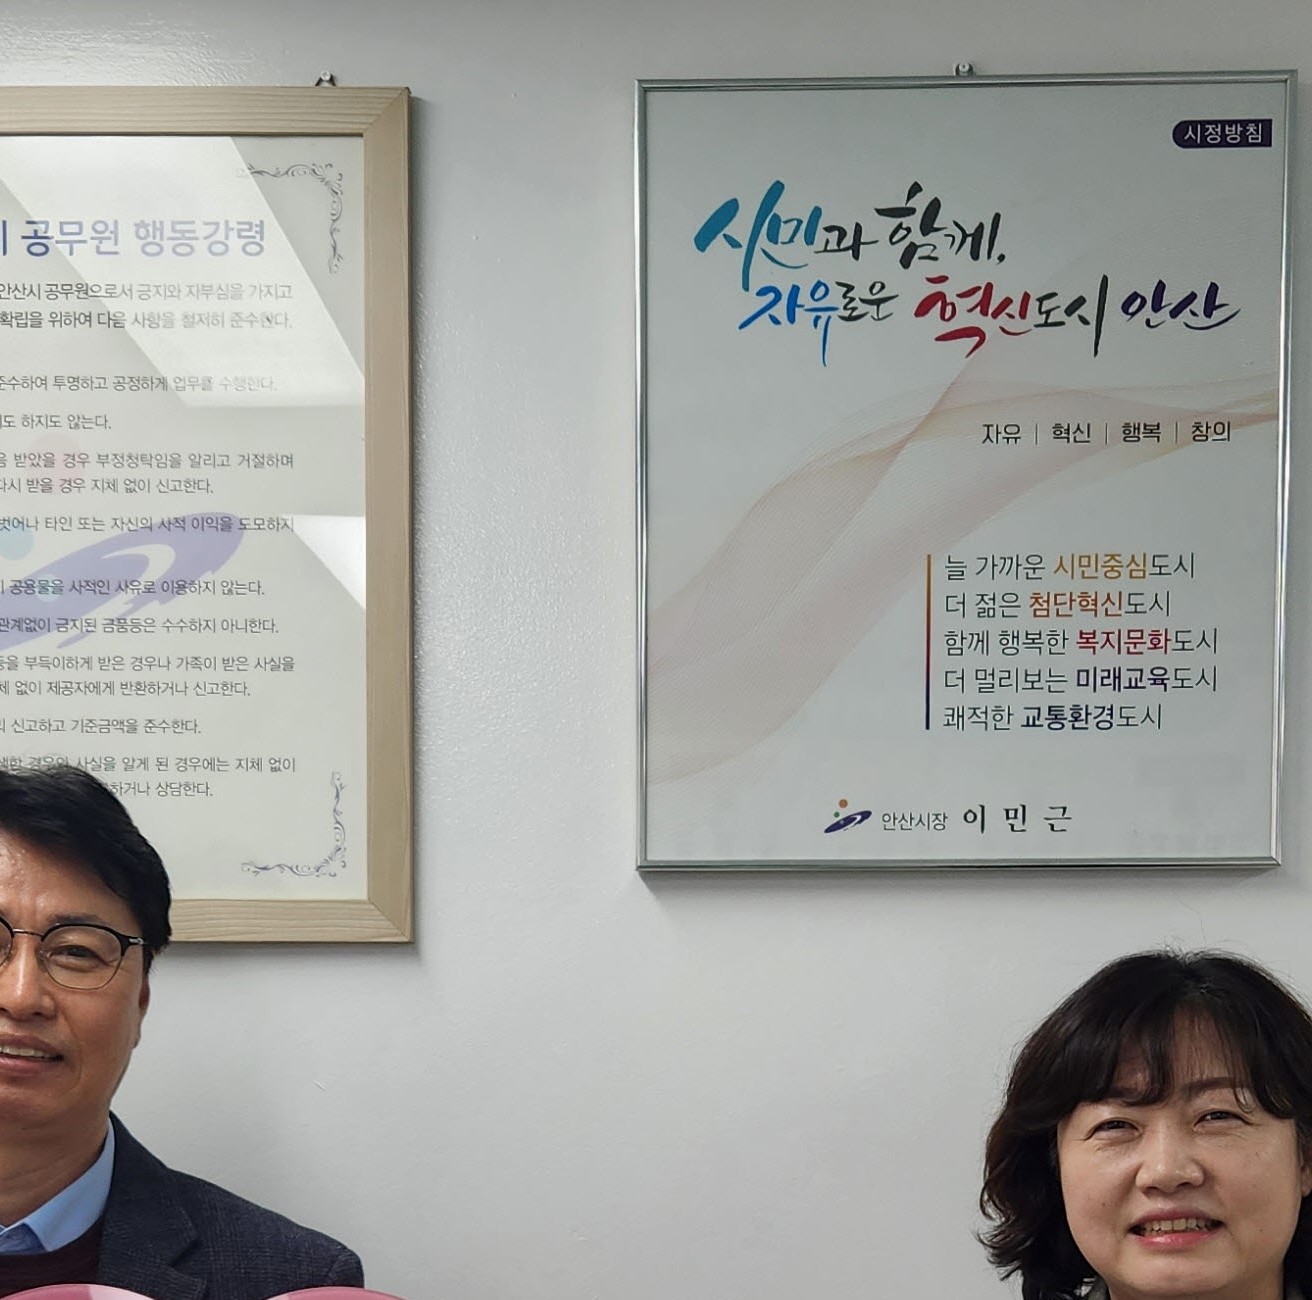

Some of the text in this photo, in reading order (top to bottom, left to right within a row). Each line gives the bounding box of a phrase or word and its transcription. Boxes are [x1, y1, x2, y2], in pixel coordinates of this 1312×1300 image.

[1183, 122, 1264, 145] 시정방침
[21, 219, 121, 257] 공무원
[134, 219, 266, 257] 행동강령
[44, 282, 133, 300] 공무원으로서
[136, 282, 181, 300] 긍지와
[185, 282, 243, 300] 자부심을
[249, 282, 293, 300] 가지고
[0, 310, 43, 329] 확립을
[49, 310, 92, 329] 위하여
[97, 310, 126, 329] 다음
[131, 310, 175, 329] 사항을
[738, 274, 1242, 368] 자유로운 혁신도시 안산
[53, 374, 107, 392] 투명하고
[113, 374, 168, 392] 공정하게
[21, 414, 62, 430] 하지도
[67, 414, 111, 430] 않는다.
[981, 421, 1232, 447] 자유 혁신 행복 창의
[14, 452, 55, 469] 받았을
[62, 452, 90, 469] 경우
[96, 452, 182, 469] 부정청탁임을
[189, 452, 230, 469] 알리고
[237, 452, 294, 469] 거절하며
[26, 477, 53, 494] 받을
[59, 477, 86, 494] 경우
[91, 477, 118, 494] 지체
[124, 477, 151, 494] 없이
[155, 477, 214, 494] 신고한다.
[45, 515, 72, 532] 타인
[78, 515, 105, 532] 또는
[111, 515, 153, 532] 자신의
[158, 515, 186, 532] 사적
[191, 515, 233, 532] 이익을
[238, 515, 294, 532] 도모하지
[944, 552, 1196, 581] 늘 가까운 시민중심도시
[9, 579, 63, 596] 공용물을
[69, 579, 109, 596] 사적인
[115, 579, 156, 596] 사유로
[161, 579, 215, 596] 이용하지
[221, 579, 265, 596] 않는다.
[944, 591, 1171, 618] 더 젊은 첨단혁신도시
[56, 617, 96, 635] 금지된
[102, 617, 156, 635] 금품등은
[161, 617, 215, 635] 수수하지
[221, 617, 279, 635] 아니한다.
[944, 628, 1218, 657] 함께 행복한 복지문화도시
[24, 655, 92, 672] 부득이하게
[98, 655, 125, 672] 받은
[130, 655, 171, 672] 경우나
[176, 655, 217, 672] 가족이
[222, 655, 249, 672] 받은
[254, 655, 294, 672] 사실을
[944, 665, 1218, 694] 더 멀리보는 미래교육도시
[15, 681, 41, 697] 없이
[47, 681, 114, 697] 제공자에게
[120, 681, 188, 697] 반환하거나
[193, 681, 251, 697] 신고한다.
[11, 718, 66, 734] 신고하고
[71, 718, 138, 734] 기준금액을
[143, 718, 201, 734] 준수한다.
[943, 703, 1163, 732] 쾌적한 교통환경도시
[76, 756, 116, 772] 사실을
[122, 755, 148, 772] 알게
[156, 755, 170, 772] 된
[175, 755, 229, 772] 경우에는
[235, 755, 262, 772] 지체
[269, 755, 296, 772] 없이
[105, 781, 213, 797] 하거나 상담한다.
[881, 810, 948, 832] 안산시장
